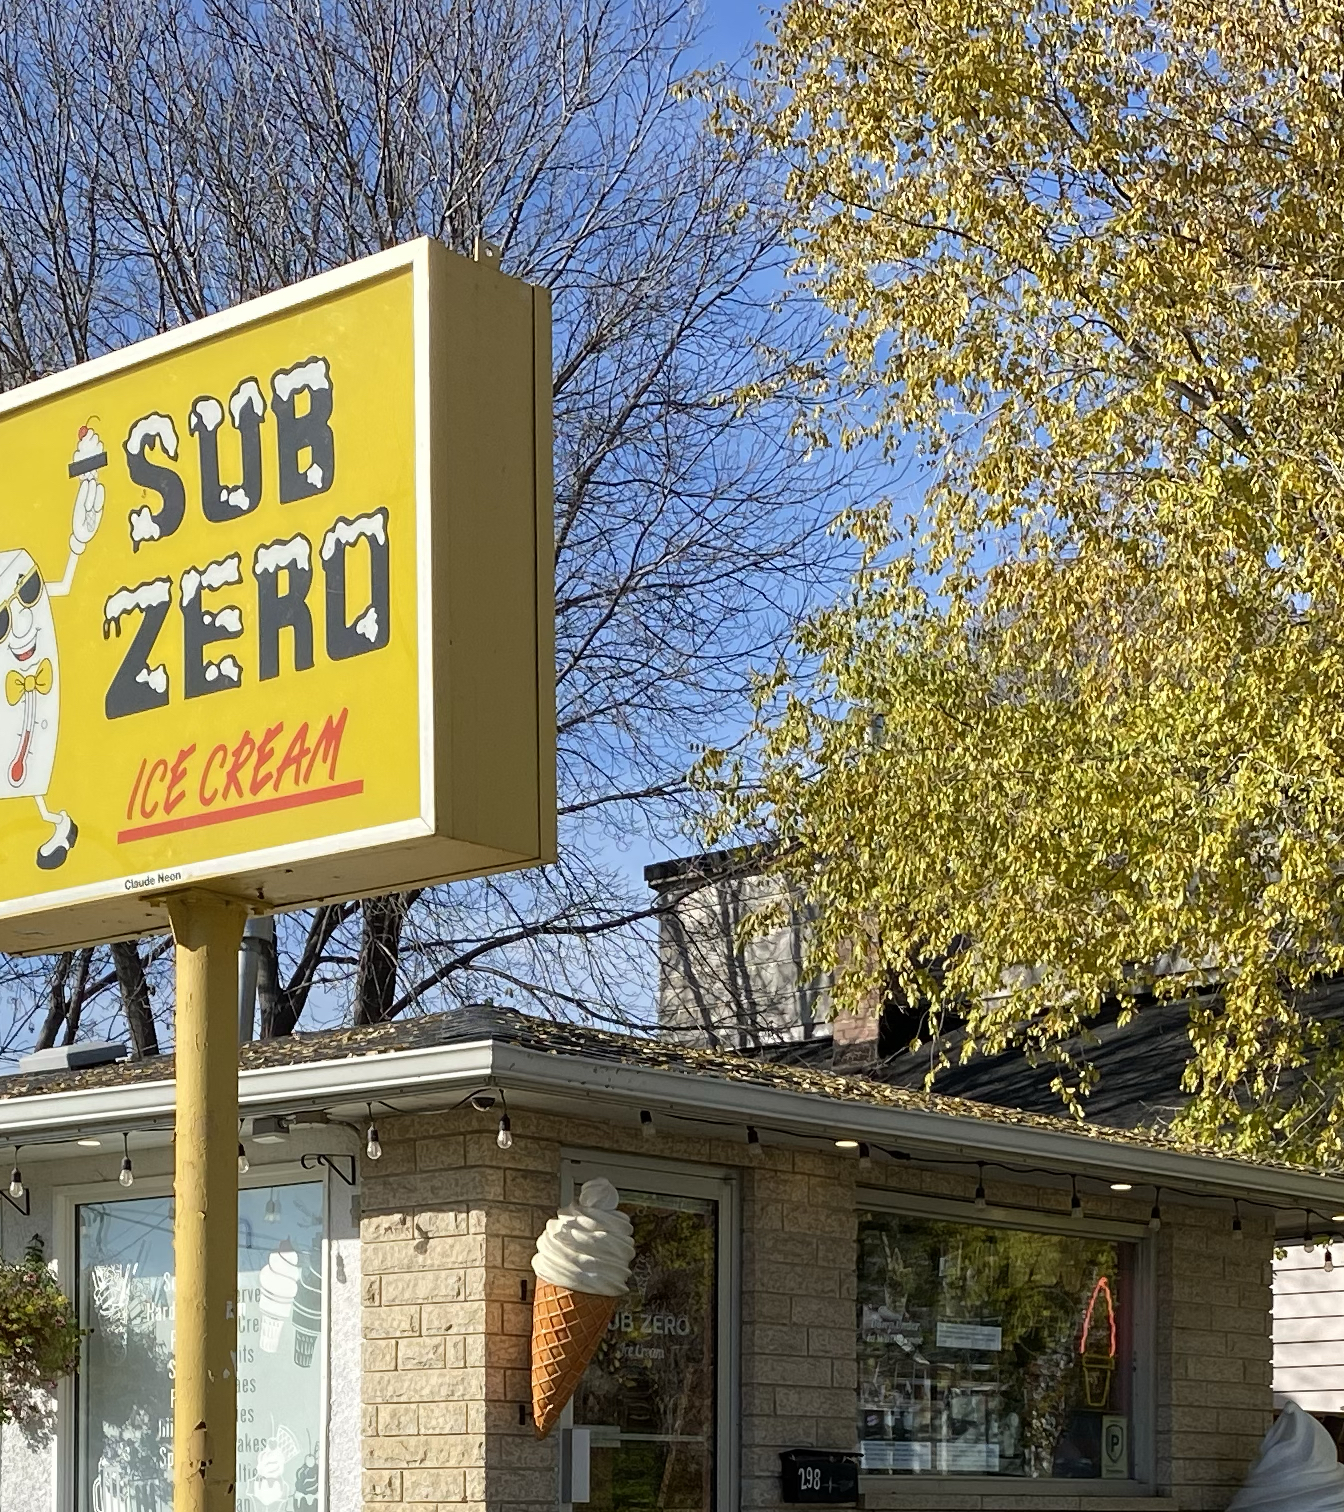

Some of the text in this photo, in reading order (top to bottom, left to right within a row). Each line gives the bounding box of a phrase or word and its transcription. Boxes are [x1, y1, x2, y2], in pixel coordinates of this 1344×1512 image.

[122, 356, 336, 553] SUB
[102, 506, 390, 720] ZERO
[126, 707, 349, 820] ICE CREAM
[124, 871, 182, 890] Claude Neon
[608, 1311, 690, 1336] UB ZERO
[1110, 1434, 1120, 1453] P
[798, 1466, 821, 1490] 298
